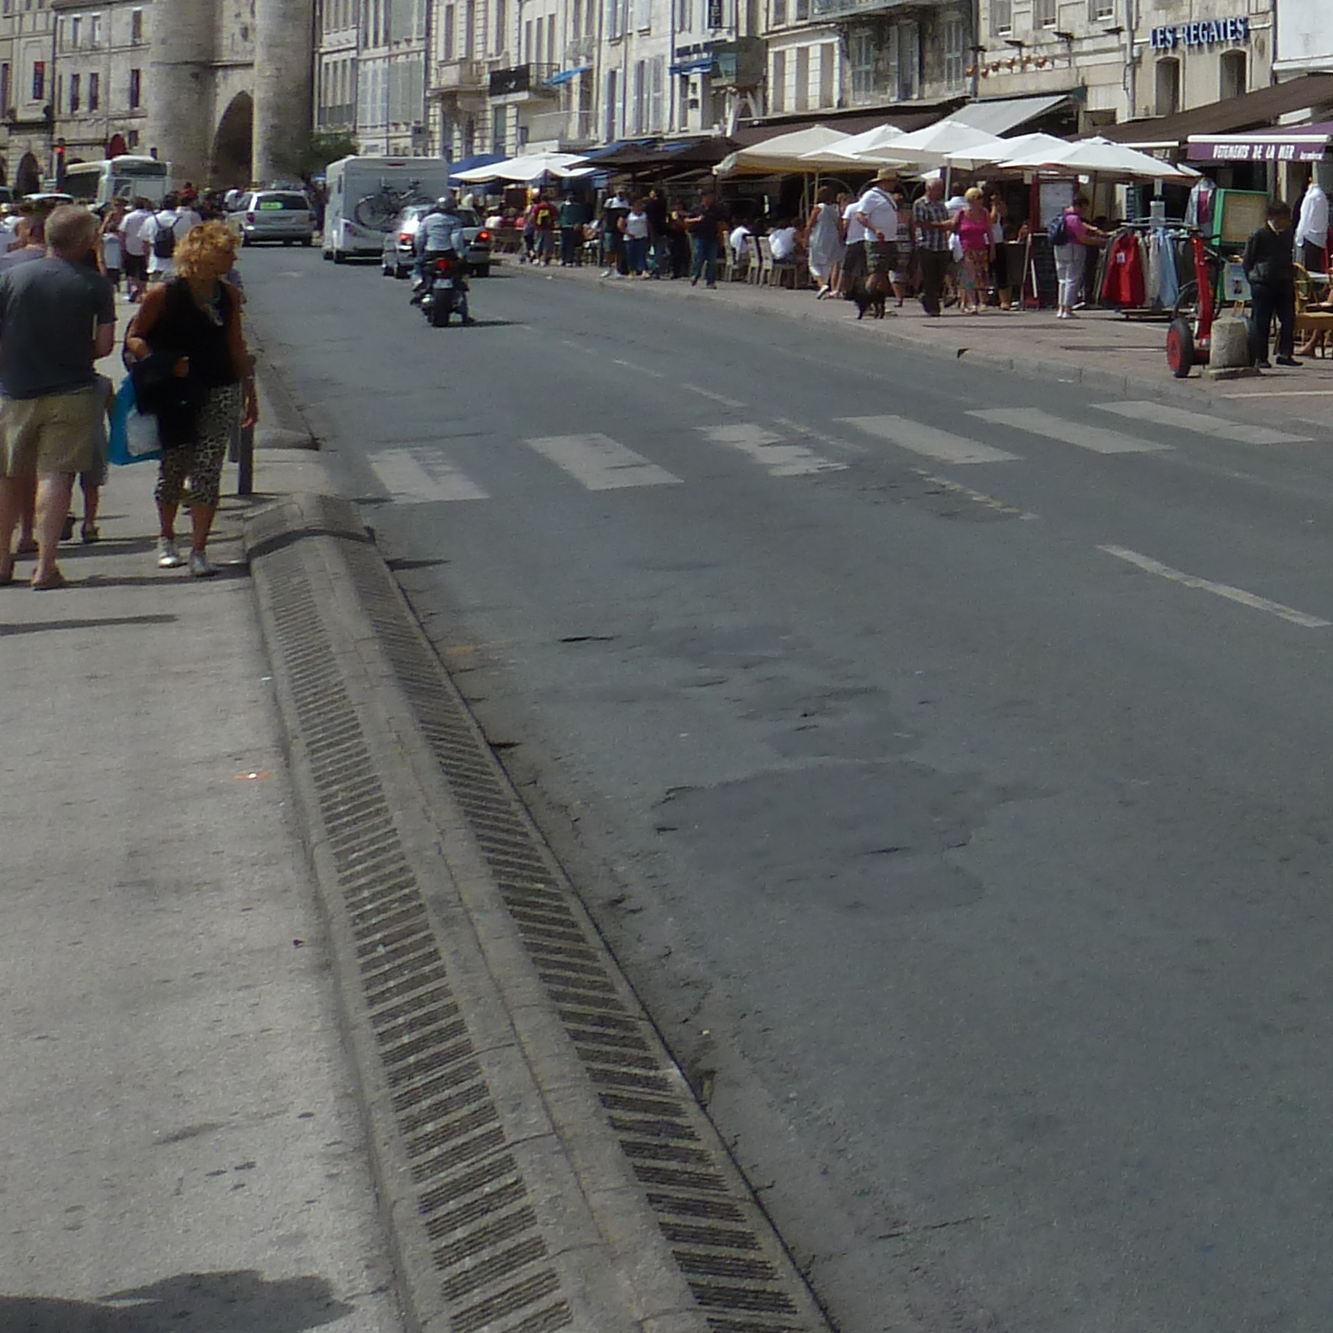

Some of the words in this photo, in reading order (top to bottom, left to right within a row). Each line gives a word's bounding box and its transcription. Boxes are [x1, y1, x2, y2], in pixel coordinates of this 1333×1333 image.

[1149, 25, 1177, 49] LES
[1180, 16, 1250, 47] REGATES
[1252, 145, 1263, 159] DE
[1265, 145, 1276, 159] LA
[1278, 145, 1295, 159] MER
